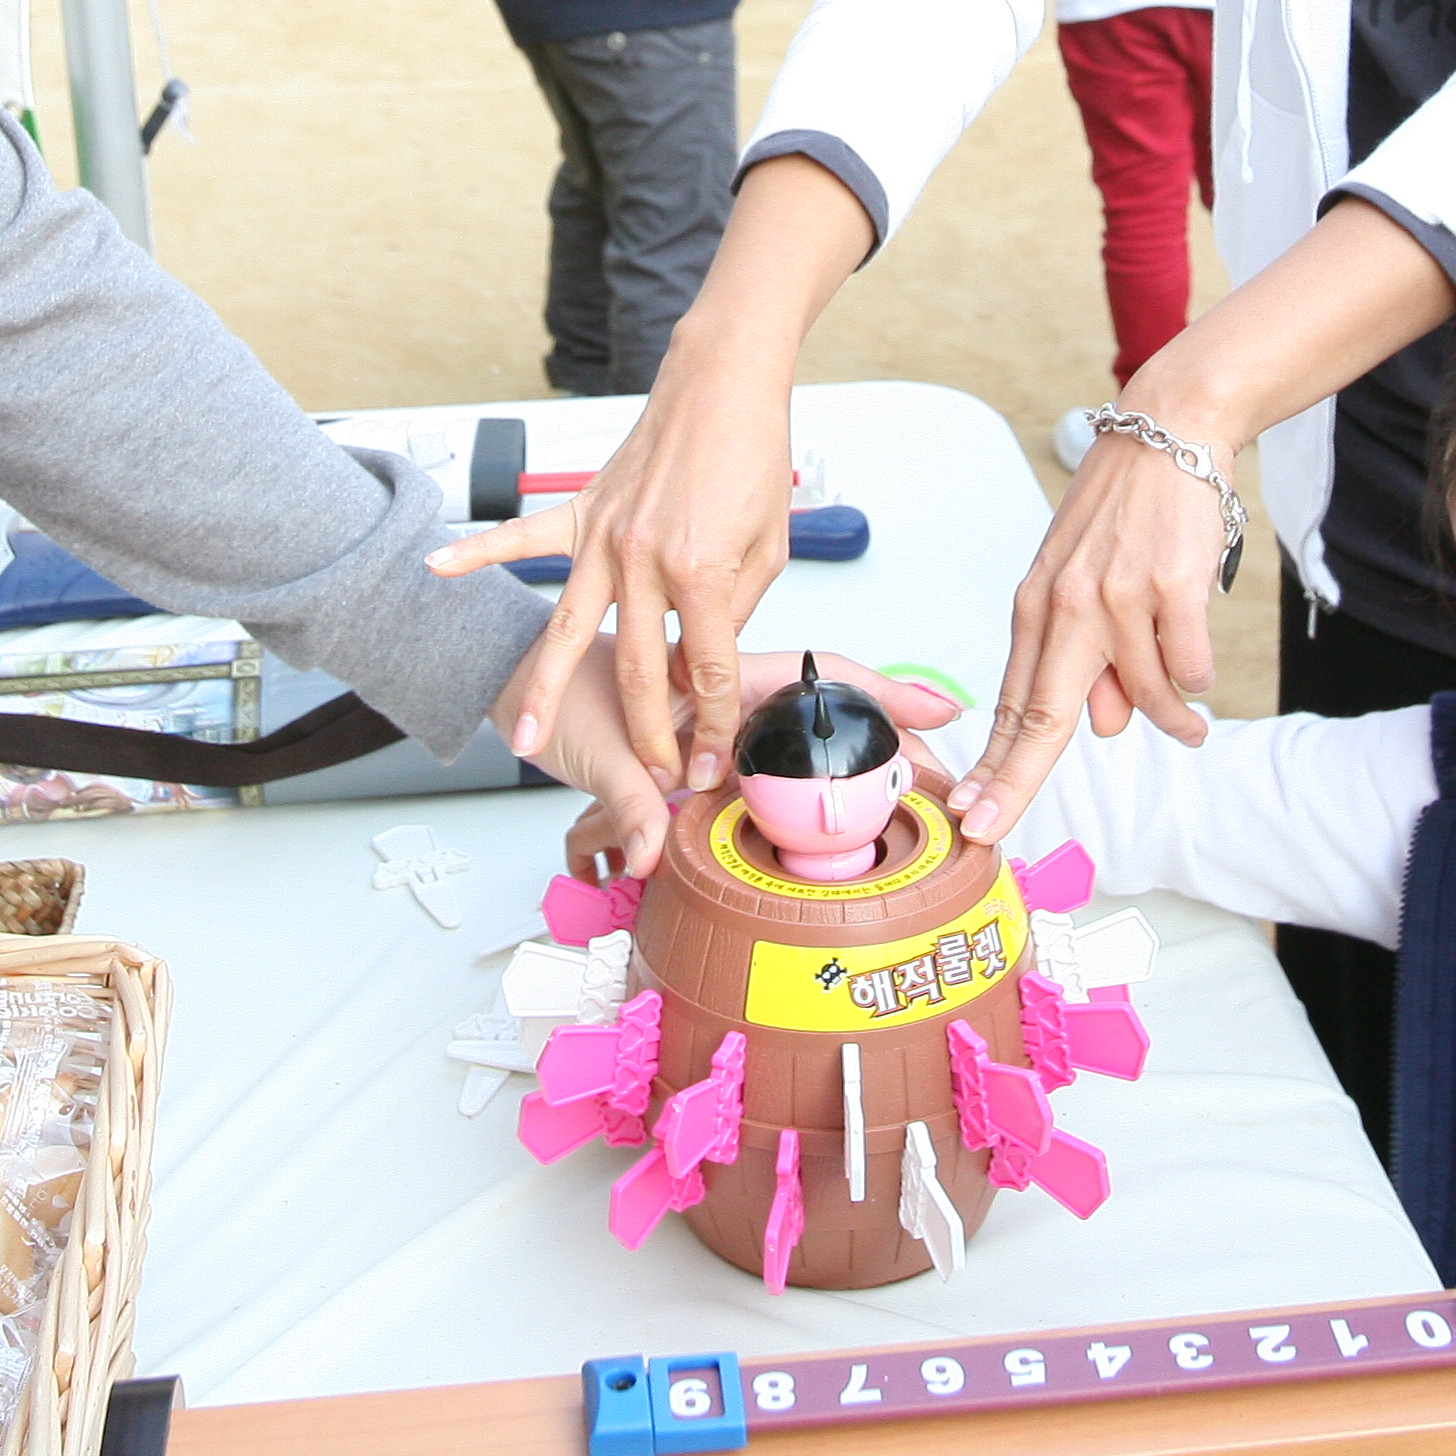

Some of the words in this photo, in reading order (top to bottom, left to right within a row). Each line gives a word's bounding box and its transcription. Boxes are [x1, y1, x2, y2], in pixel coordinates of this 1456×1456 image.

[848, 919, 1008, 1018] 해적룰렛
[1248, 1324, 1298, 1363] 2
[1328, 1317, 1369, 1358] 1
[1403, 1309, 1454, 1348] 0
[1002, 1347, 1047, 1386] 5
[1086, 1340, 1131, 1378] 4
[1167, 1332, 1213, 1368] 3
[751, 1371, 796, 1411] 8
[839, 1364, 882, 1404] 7
[919, 1356, 966, 1395] 6
[667, 1377, 713, 1417] 9
